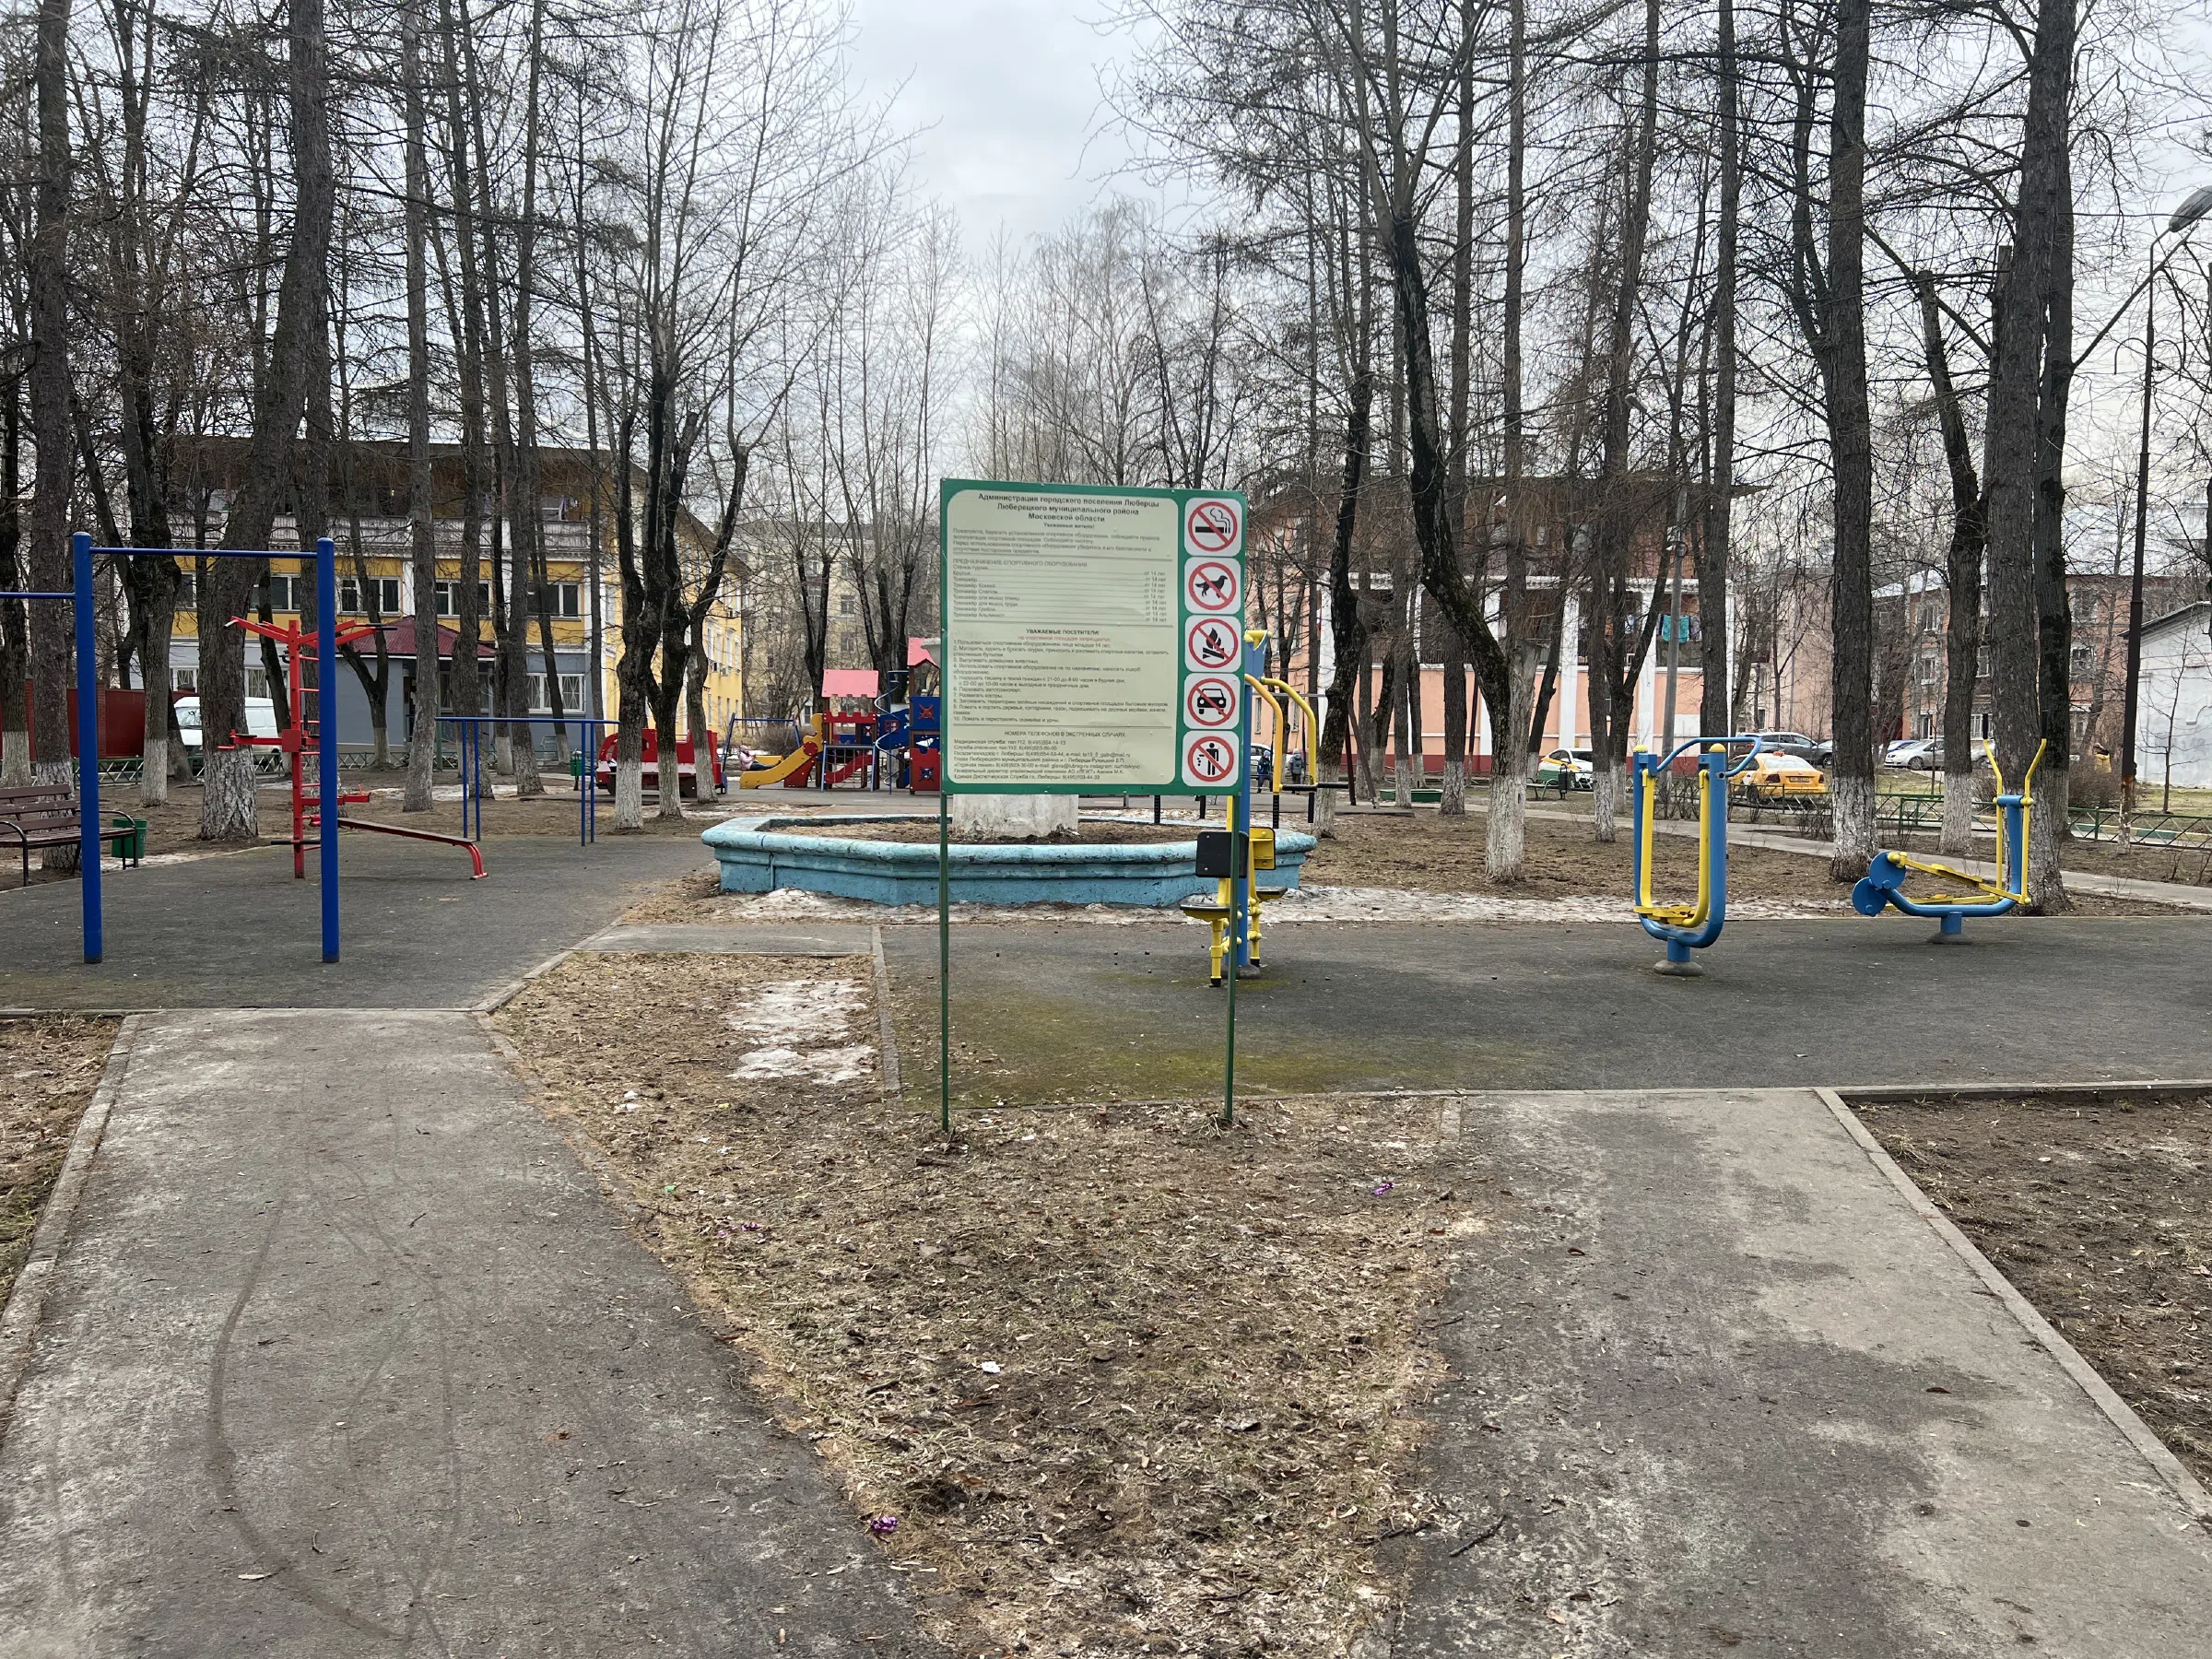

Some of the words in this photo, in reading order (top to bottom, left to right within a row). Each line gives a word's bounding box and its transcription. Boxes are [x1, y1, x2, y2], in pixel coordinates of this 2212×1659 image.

[978, 493, 1038, 503] Администрация
[1124, 499, 1159, 508] Люберцы
[997, 503, 1047, 511] Люберецкого
[1049, 506, 1111, 514] муниципального
[1028, 512, 1073, 521] Московской
